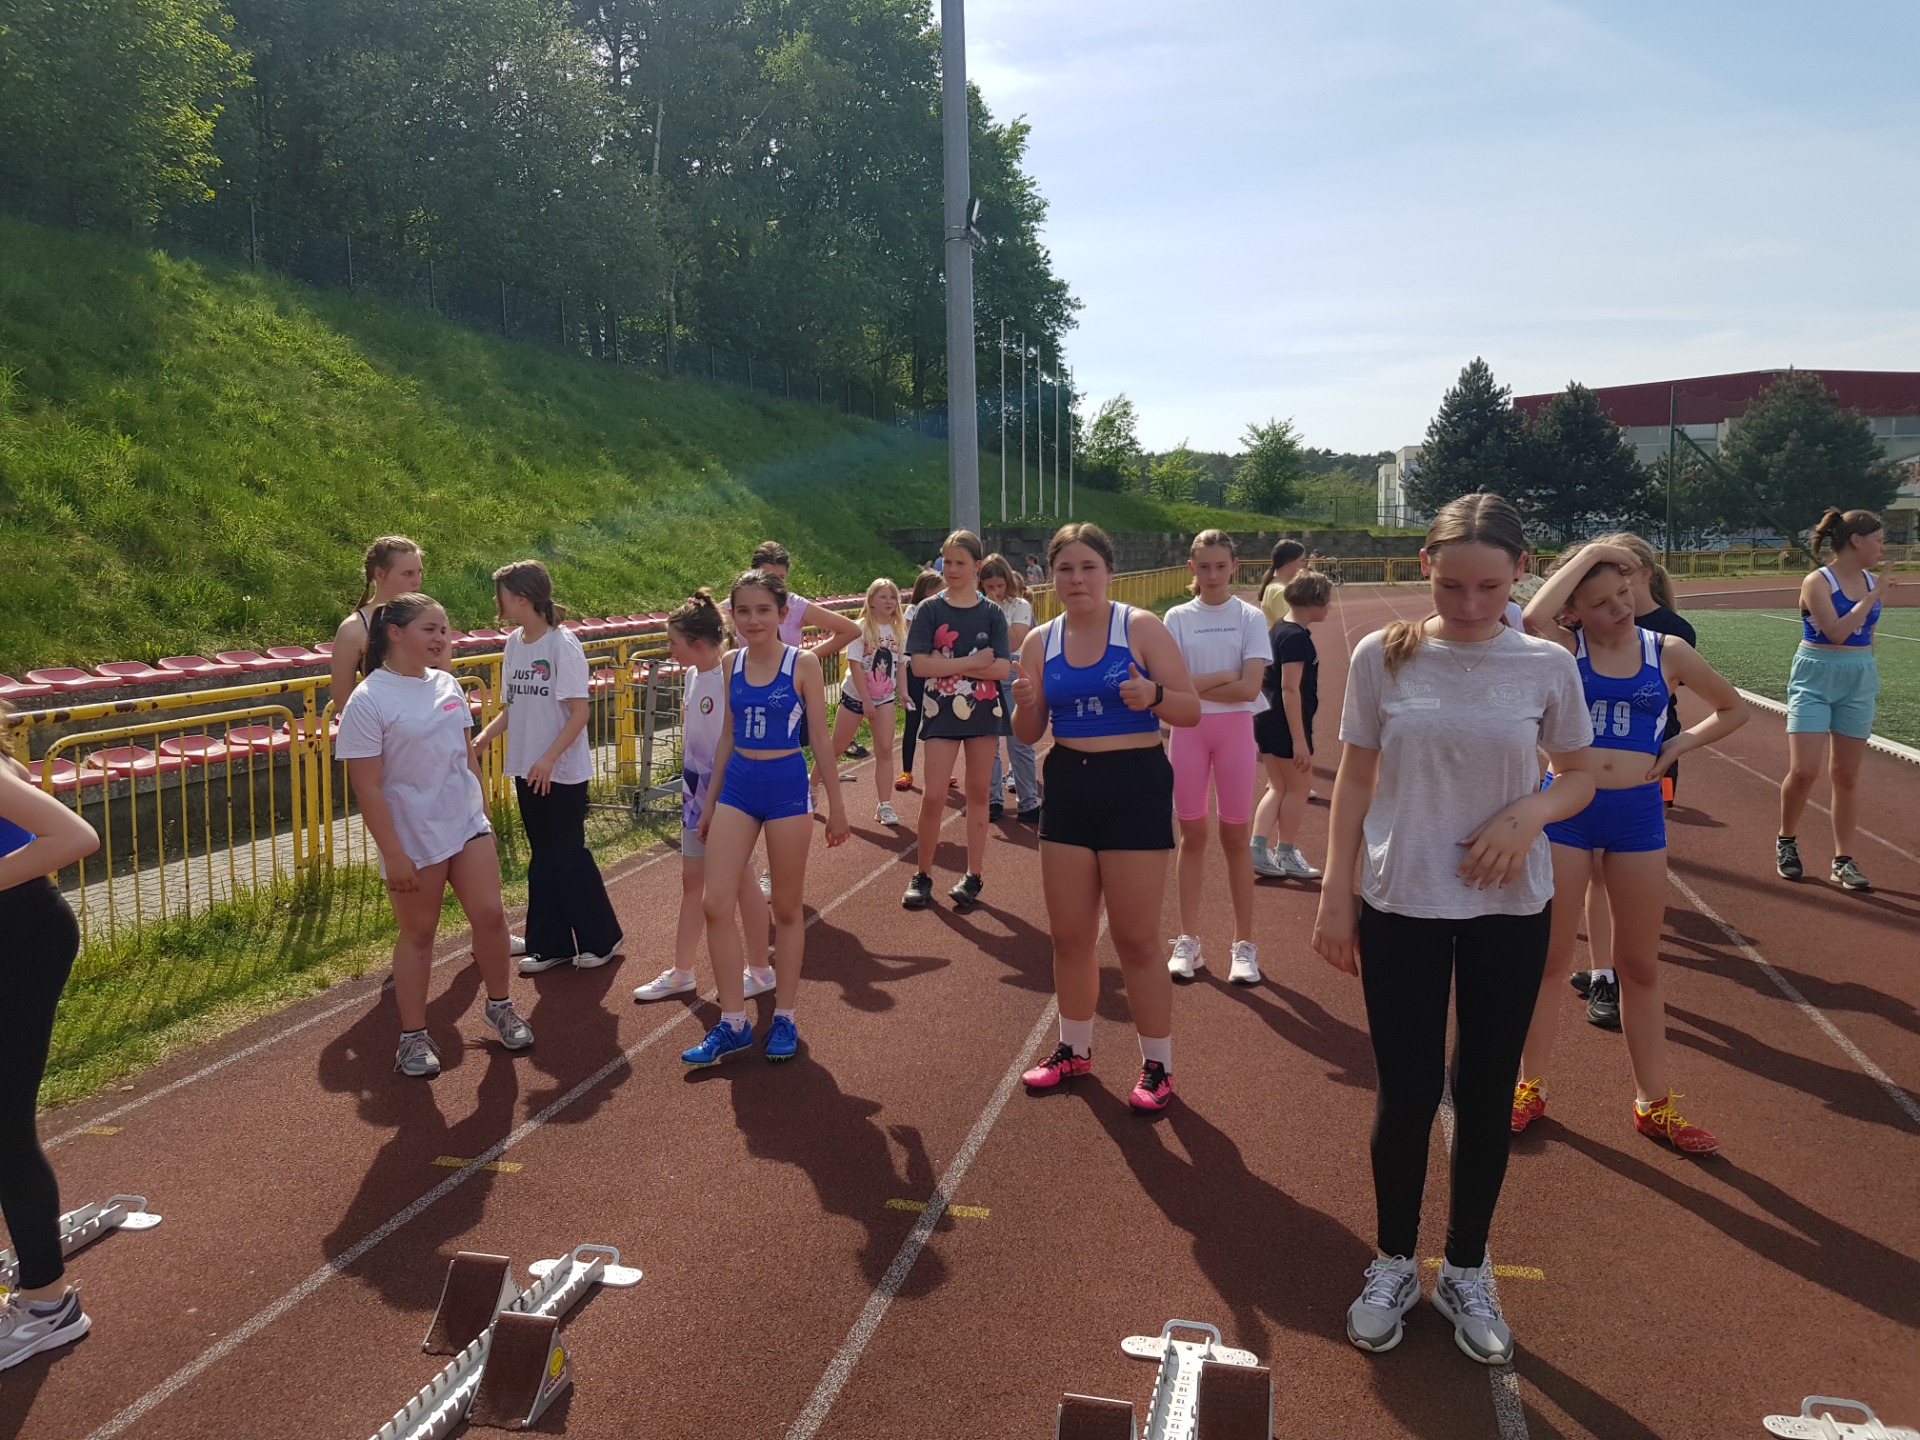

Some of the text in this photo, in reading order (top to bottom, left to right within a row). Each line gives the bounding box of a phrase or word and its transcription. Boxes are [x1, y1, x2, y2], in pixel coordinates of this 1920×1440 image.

[512, 669, 537, 680] JUST
[1074, 696, 1104, 717] 14
[1590, 700, 1631, 737] 49
[744, 706, 767, 739] 15
